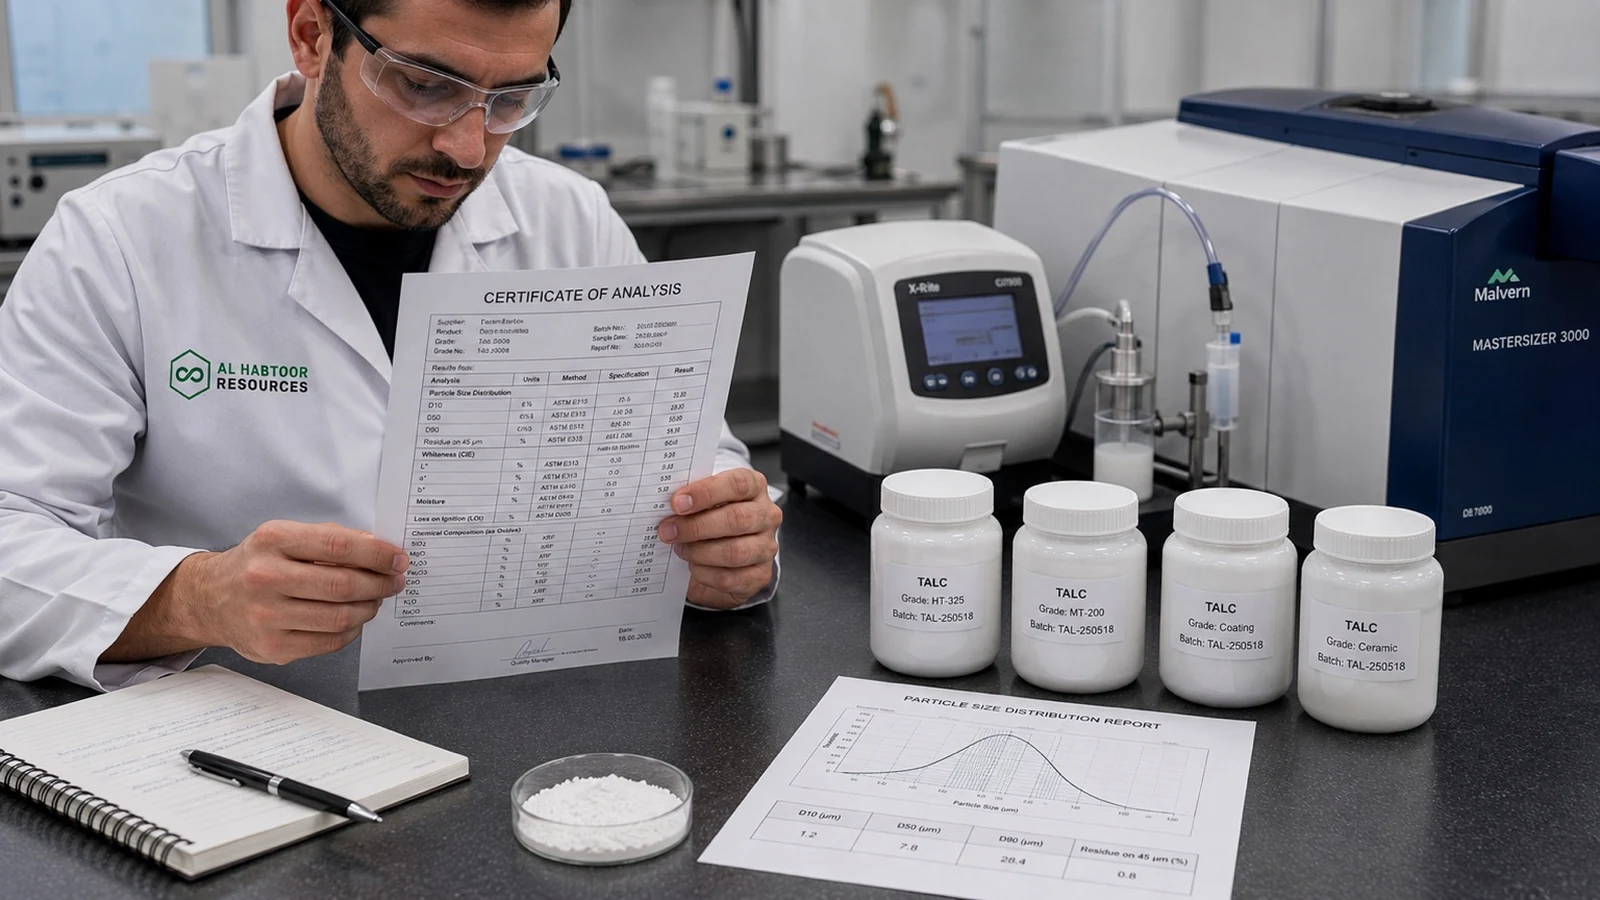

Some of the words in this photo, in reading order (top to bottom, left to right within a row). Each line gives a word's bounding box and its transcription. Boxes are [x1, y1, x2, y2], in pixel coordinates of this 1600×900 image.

[483, 287, 584, 304] CERTIFICATE
[588, 288, 608, 300] OF
[612, 283, 682, 299] ANALYSIS
[908, 282, 940, 294] X-Rite
[1474, 286, 1531, 302] Malvern
[1473, 332, 1556, 351] MASTERSIZER
[1560, 329, 1589, 343] 3000
[217, 362, 235, 374] AL
[241, 364, 308, 378] HABTOOR
[608, 371, 649, 380] Specification
[217, 378, 308, 392] RESOURCES
[917, 577, 947, 588] TALC
[901, 593, 929, 604] Grade:
[931, 595, 964, 605] HT-325
[1056, 587, 1087, 599] TALC
[1039, 604, 1067, 616] Grade:
[1069, 608, 1104, 617] MT-200
[1205, 602, 1236, 613] TALC
[892, 609, 917, 621] Batch:
[921, 612, 973, 623] TAL-250518
[1030, 619, 1055, 632] Batch:
[1058, 624, 1114, 635] TAL-250518
[1188, 618, 1217, 631] Grade:
[1219, 623, 1254, 634] Coating
[1345, 620, 1377, 633] TALC
[1179, 634, 1205, 647] Batch:
[1207, 639, 1263, 650] TAL-250518
[1326, 636, 1356, 650] Grade:
[1358, 642, 1397, 652] Ceramic
[1317, 652, 1344, 667] Batch:
[1346, 659, 1405, 671] TAL-250518
[904, 695, 969, 708] PARTICLE
[971, 704, 1002, 712] SIZE
[1005, 707, 1100, 723] DISTRIBUTION
[1104, 718, 1161, 730] REPORT
[799, 809, 818, 818] D10
[897, 823, 917, 831] D50
[999, 836, 1018, 844] D90
[900, 843, 918, 851] 7.8
[1080, 846, 1120, 857] Residue
[1000, 856, 1026, 865] 28.4
[1118, 871, 1136, 879] 0.8
